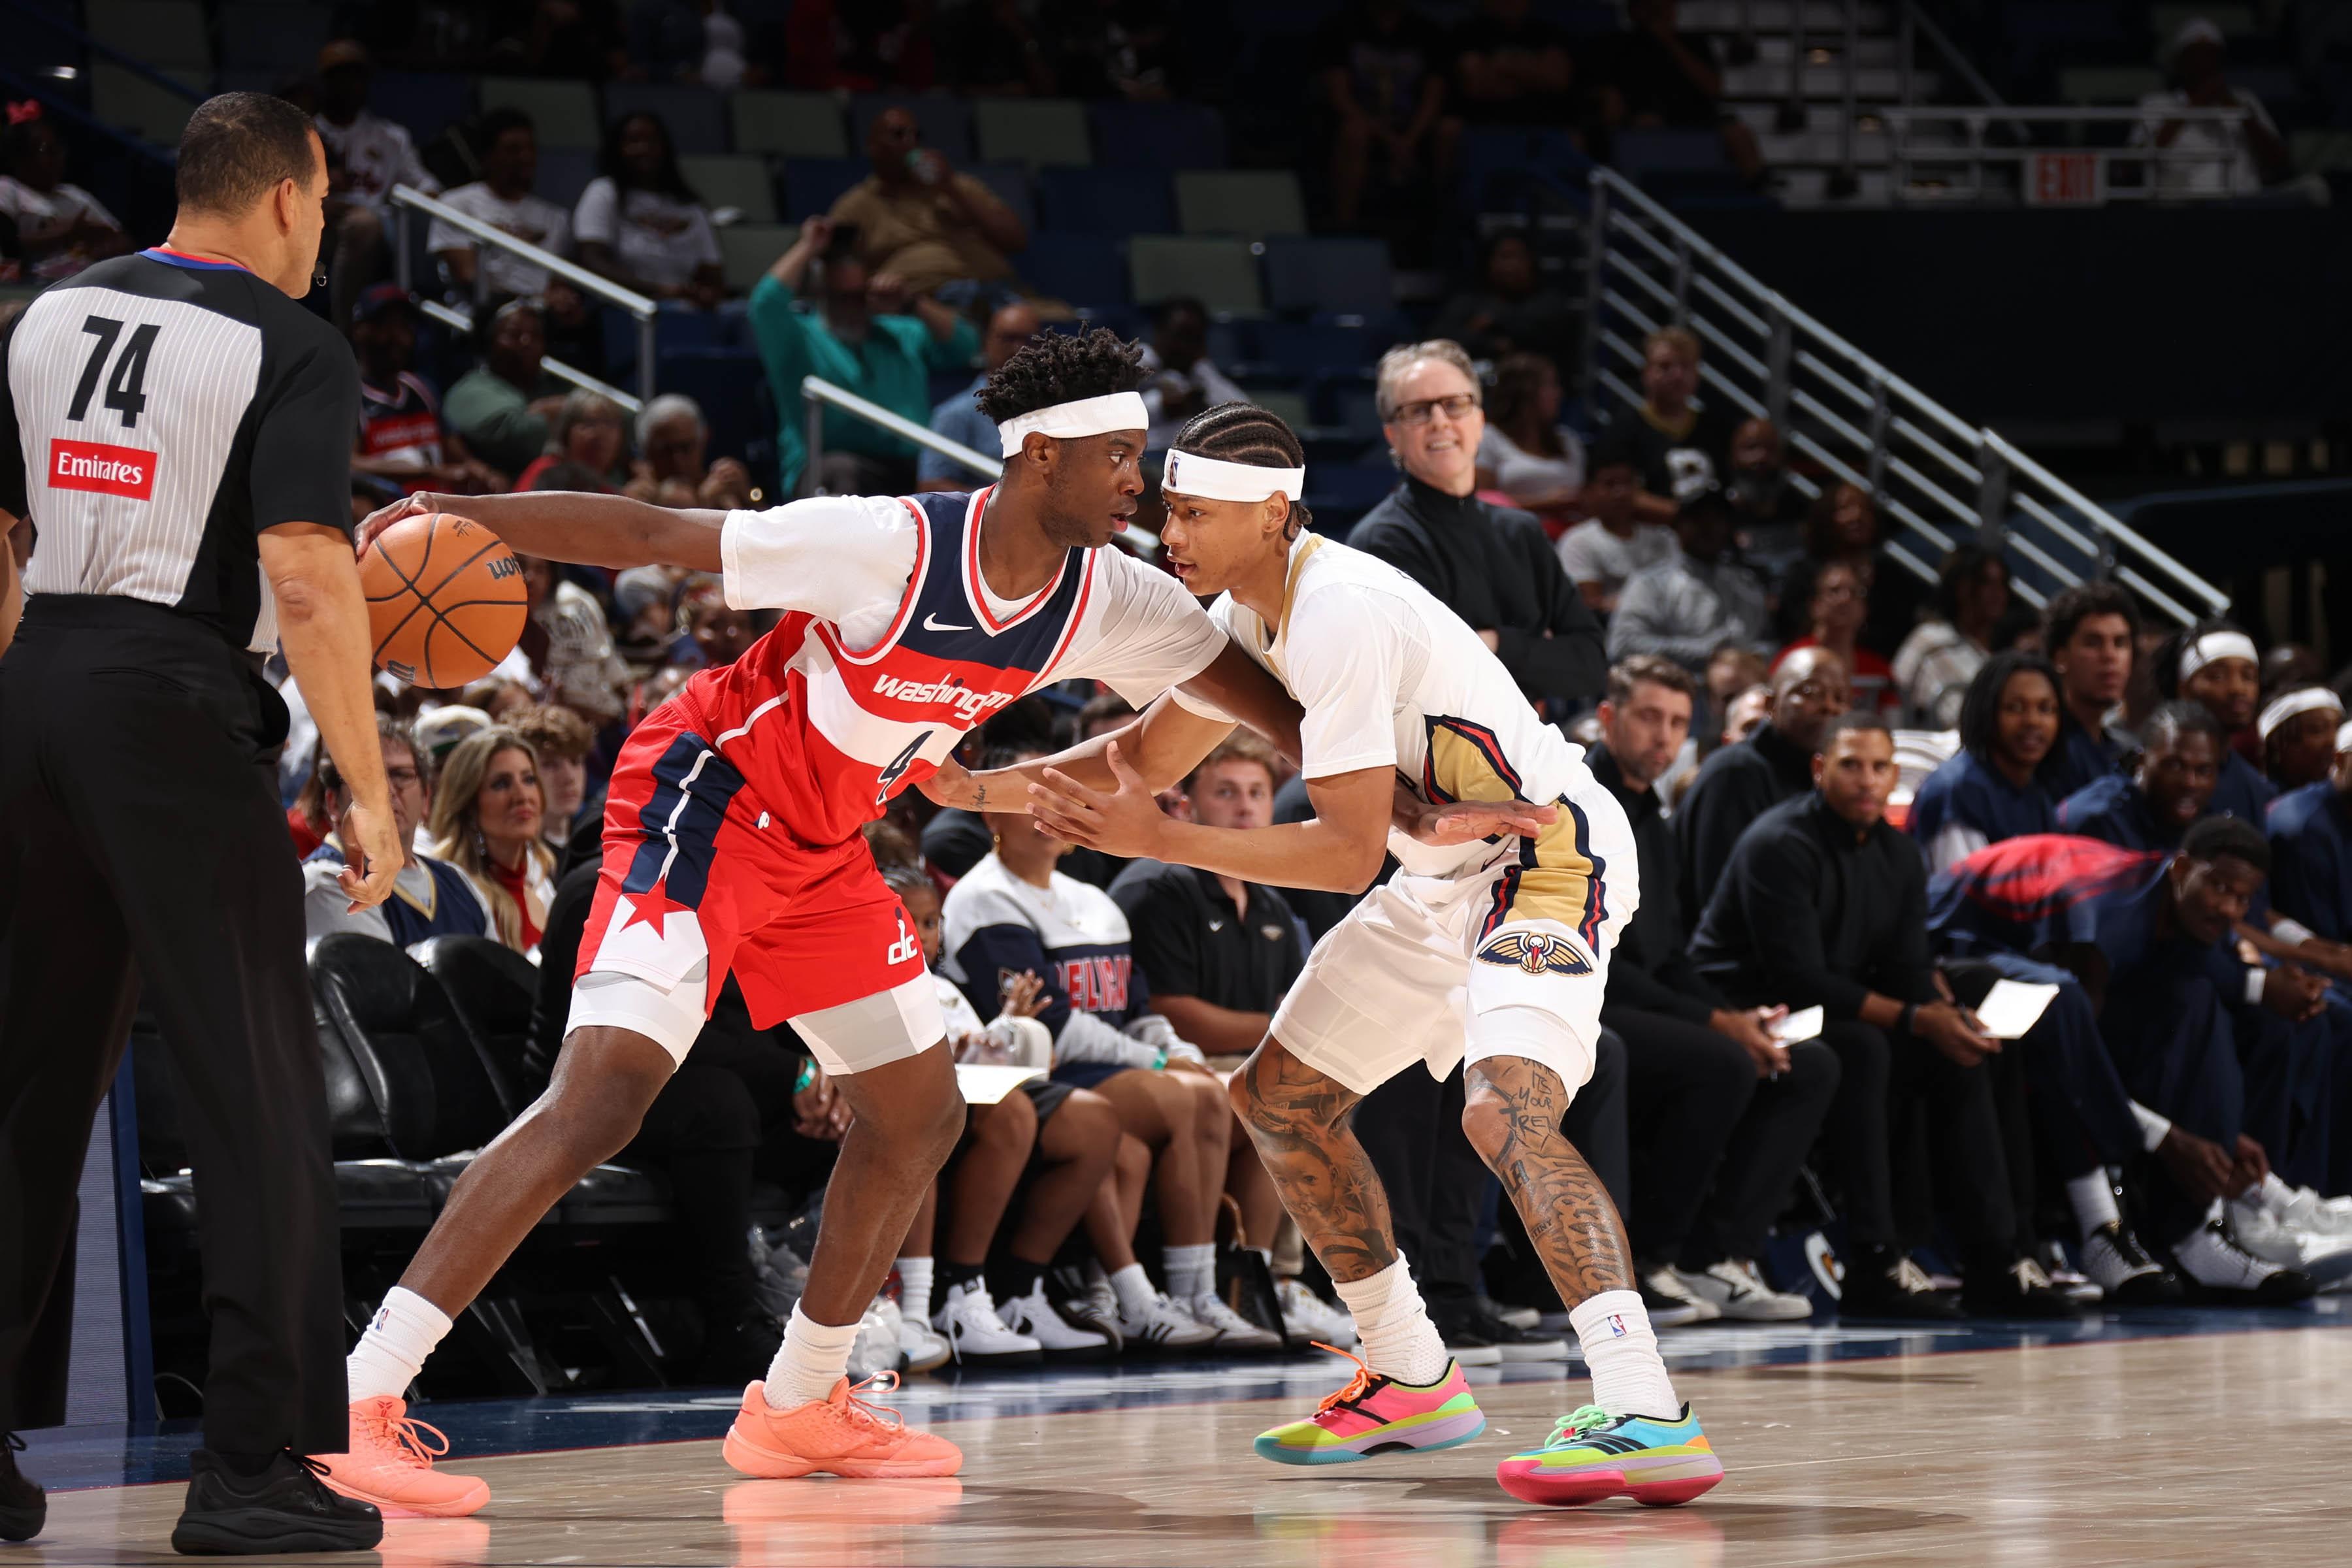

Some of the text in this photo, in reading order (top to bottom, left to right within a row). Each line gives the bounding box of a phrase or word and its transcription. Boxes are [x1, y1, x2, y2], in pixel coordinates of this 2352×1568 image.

[2036, 154, 2095, 200] EXIT
[67, 314, 162, 429] 74
[57, 451, 143, 485] Emirates
[875, 730, 935, 806] 4
